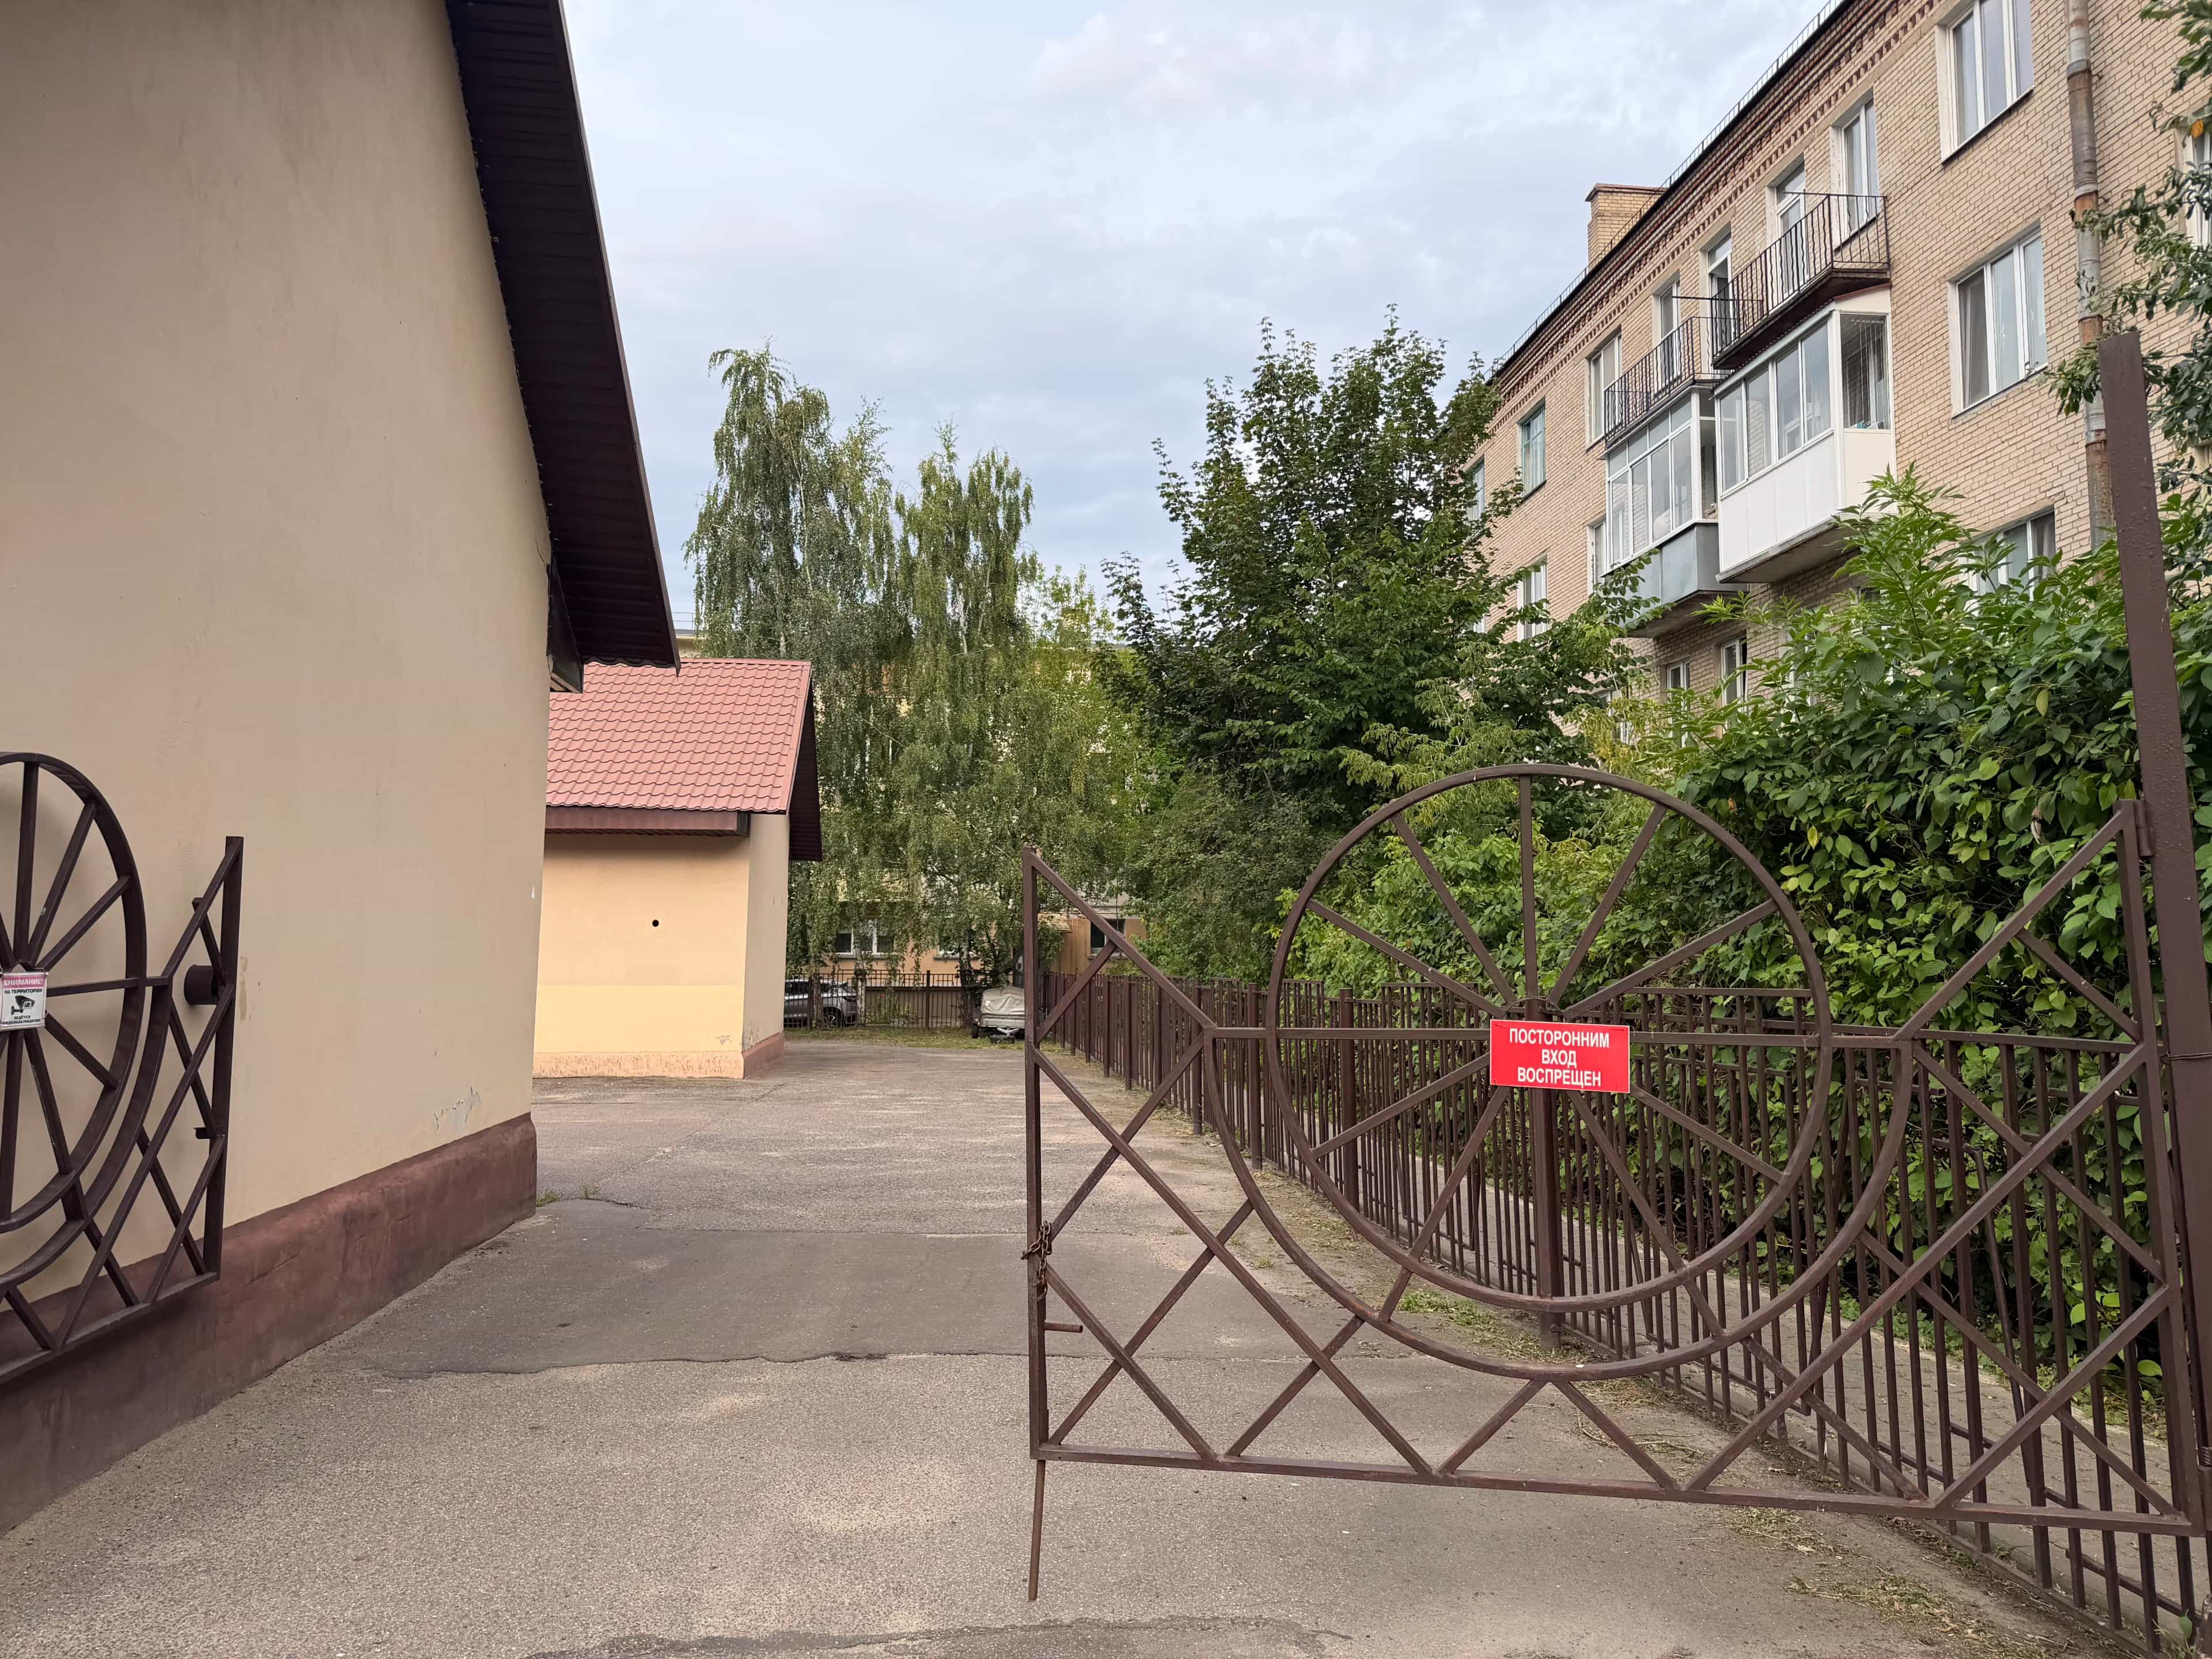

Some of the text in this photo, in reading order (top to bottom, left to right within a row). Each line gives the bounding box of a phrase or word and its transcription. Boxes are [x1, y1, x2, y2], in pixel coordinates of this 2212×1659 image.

[1509, 1028, 1609, 1047] ПОСТОРОННИМ
[1541, 1049, 1577, 1068] ВХОД
[1517, 1067, 1601, 1088] ВОСПРЕЩЕН
